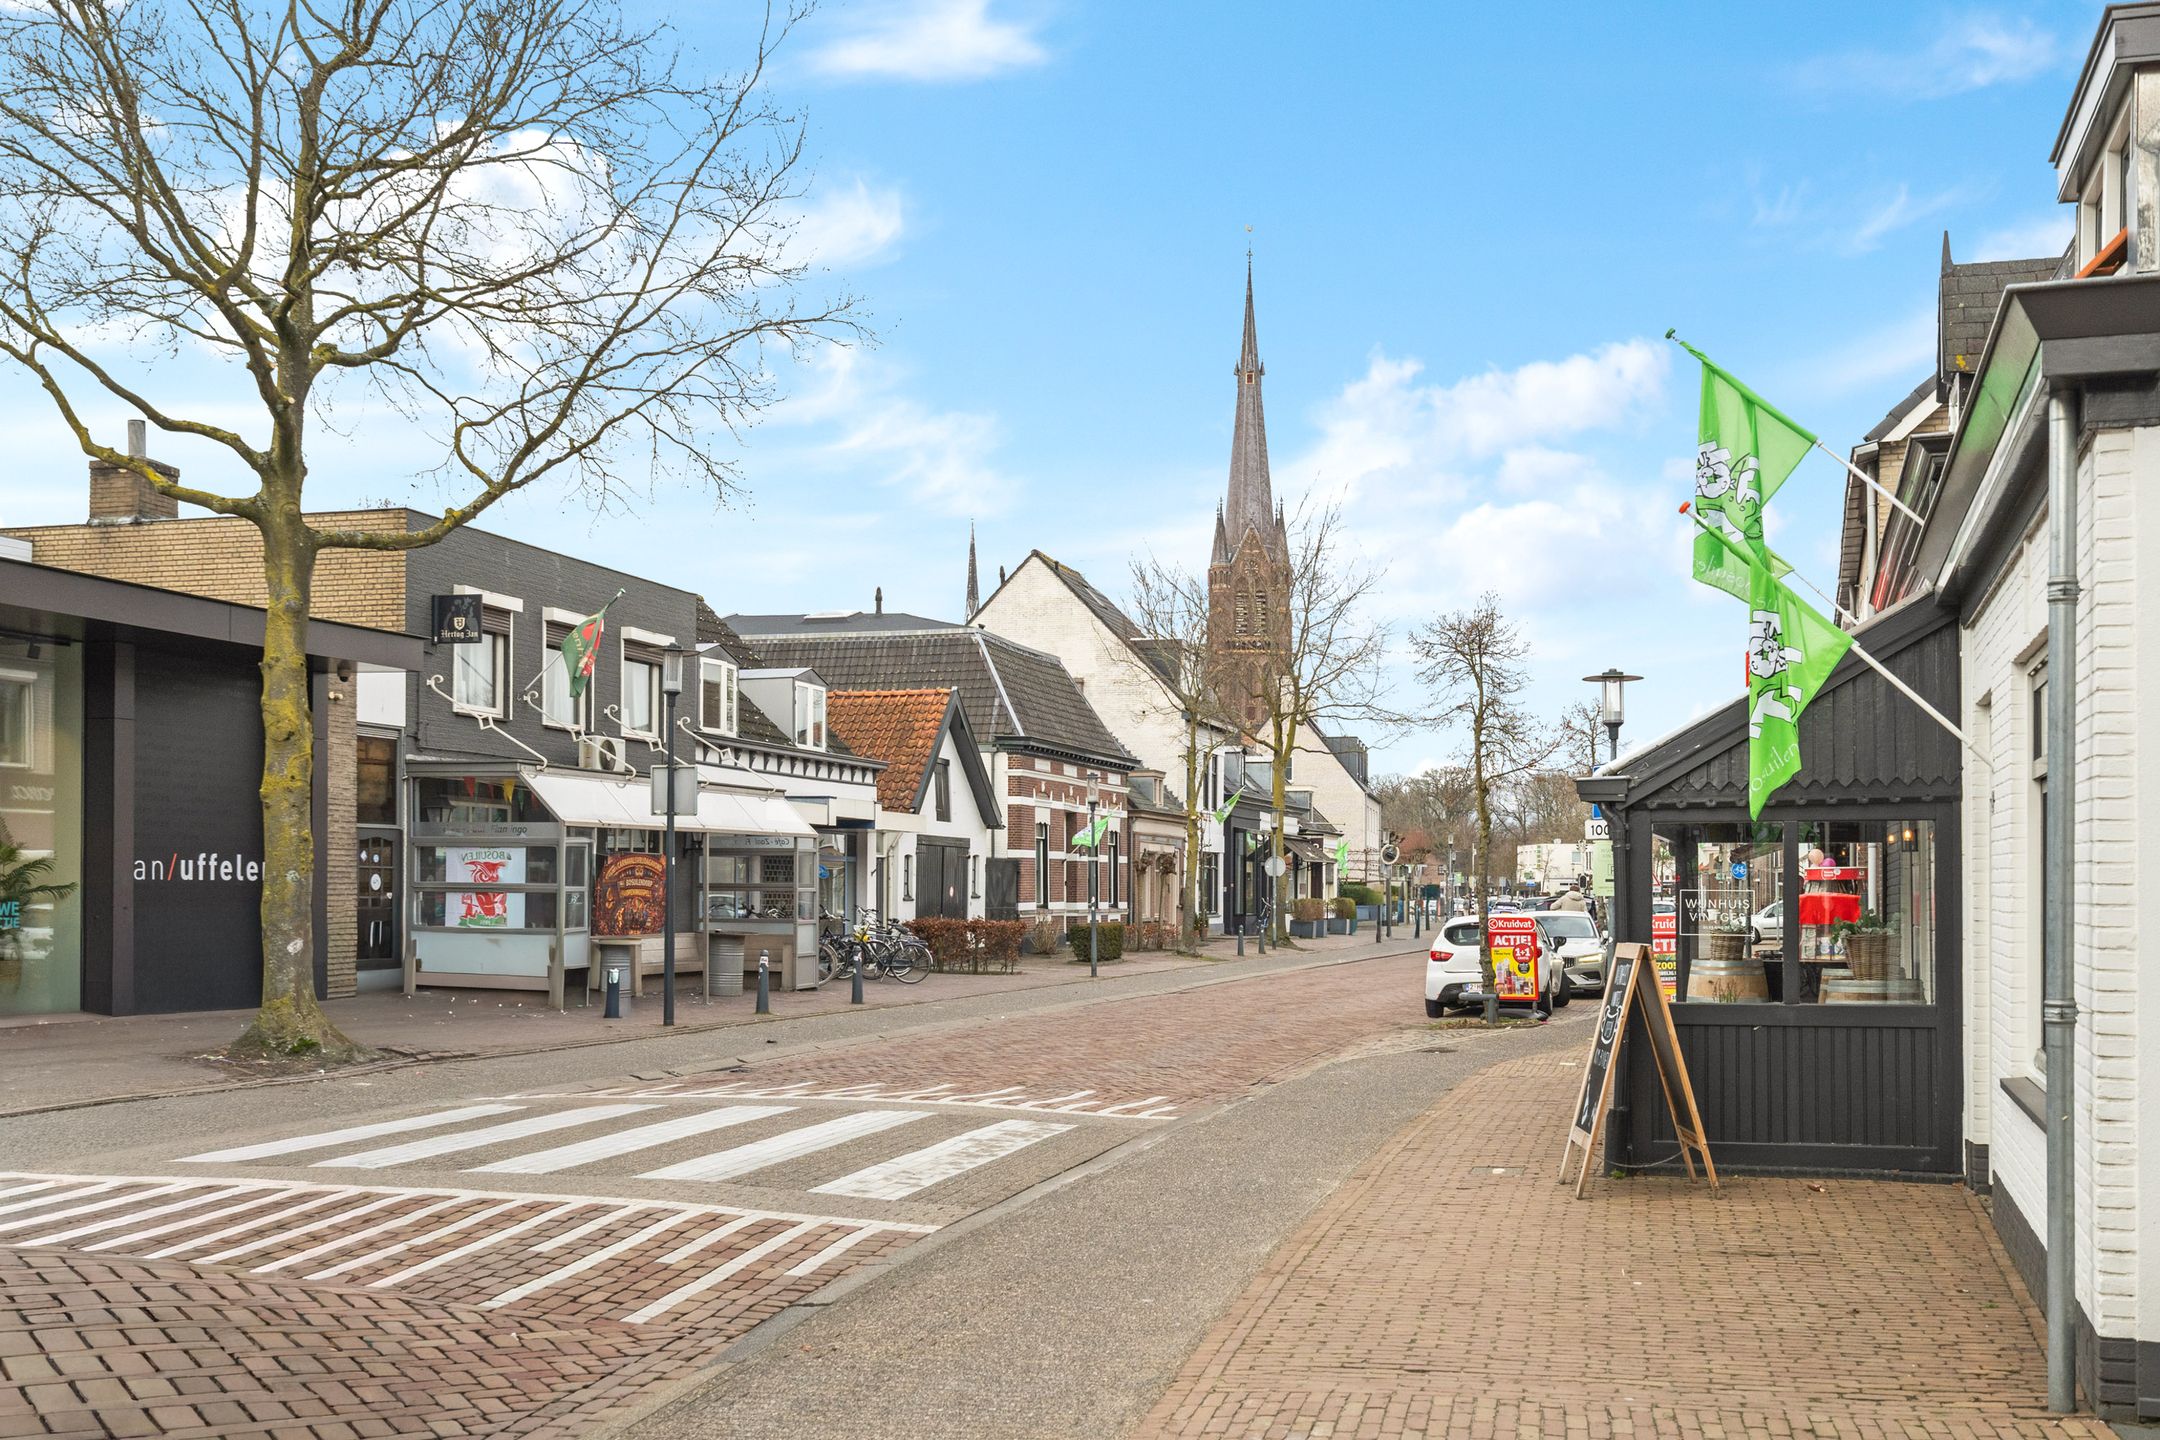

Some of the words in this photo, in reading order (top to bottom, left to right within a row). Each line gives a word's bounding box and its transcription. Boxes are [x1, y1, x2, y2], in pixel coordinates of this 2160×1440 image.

[133, 852, 265, 881] an/uffele
[0, 901, 20, 917] WE
[1499, 919, 1532, 929] Kruidvat
[1652, 918, 1676, 929] ruid
[1494, 935, 1532, 946] ACTIE!
[1652, 939, 1676, 952] CTI
[1515, 947, 1531, 957] 1+1
